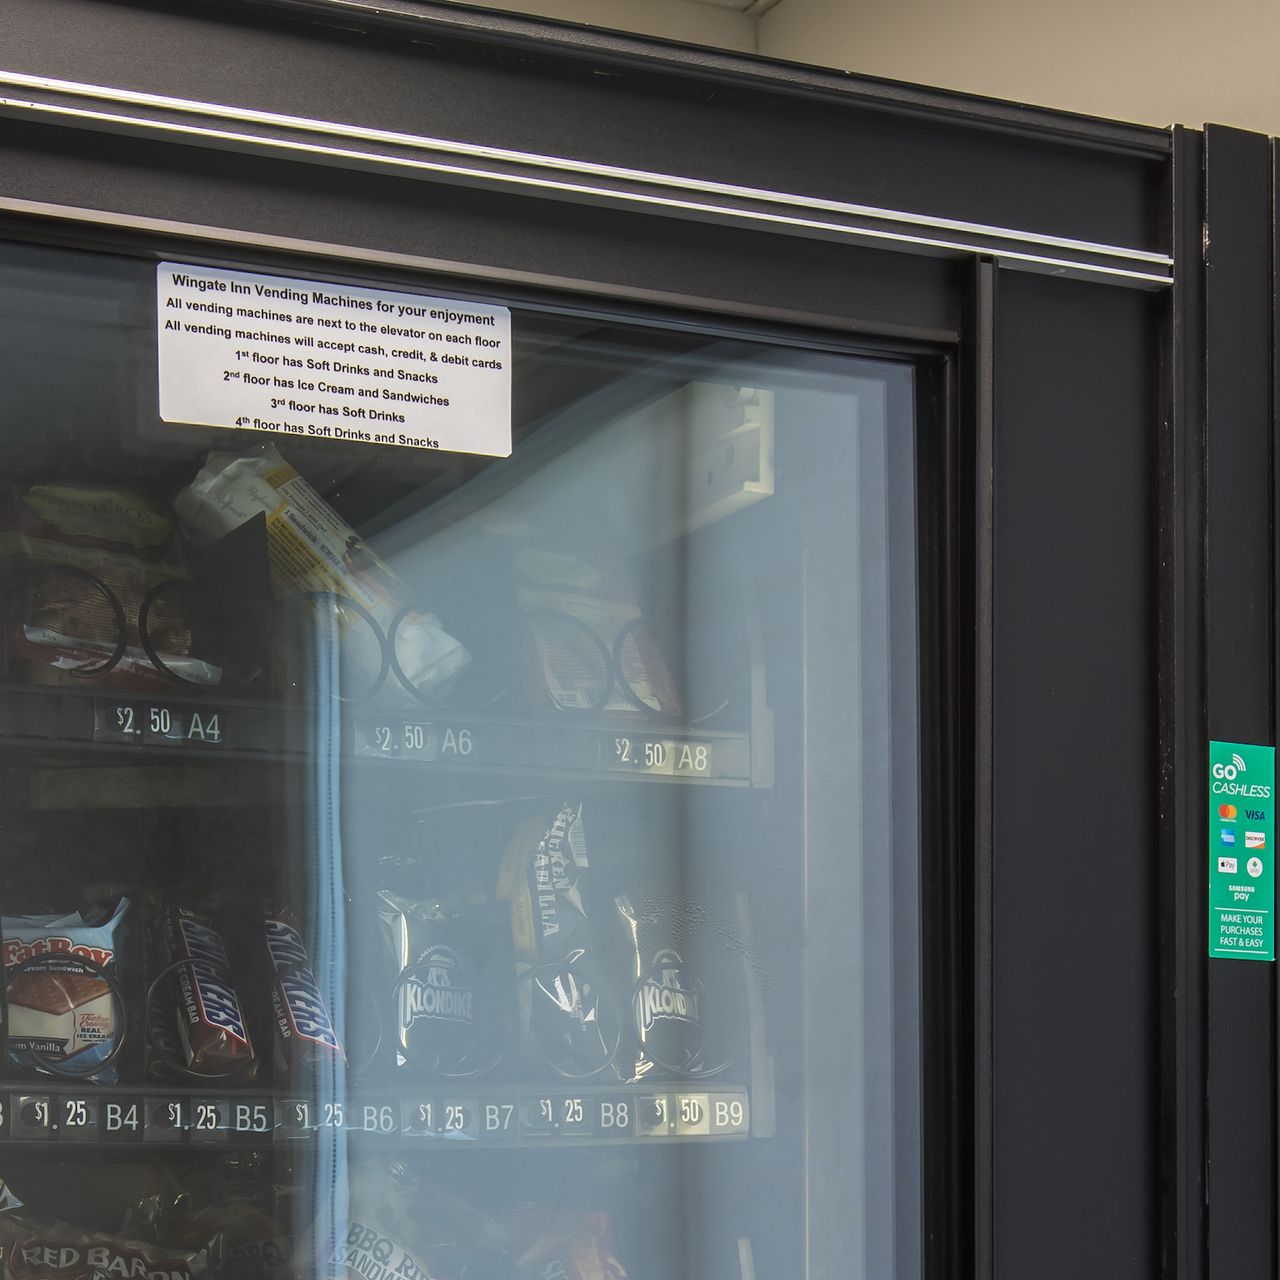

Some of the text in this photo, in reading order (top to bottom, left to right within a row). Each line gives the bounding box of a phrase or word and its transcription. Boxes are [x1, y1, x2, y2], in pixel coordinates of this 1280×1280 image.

[172, 274, 494, 326] Wingate Inn Vending Machines for your enjoyment
[166, 298, 181, 308] All
[186, 302, 232, 317] vending
[237, 309, 292, 322] machines
[296, 316, 313, 325] are
[318, 319, 342, 328] next
[345, 320, 356, 330] to
[360, 322, 377, 332] the
[381, 325, 425, 338] elevator
[446, 335, 471, 344] each
[475, 336, 500, 348] floor
[165, 320, 502, 369] All vending machines will accept cash, credit, & debit cards
[236, 350, 438, 383] 1st floor has Soft Drinks and Snacks
[224, 371, 449, 406] 2nd floor has Ice Cream and Sandwiches
[271, 399, 404, 422] 3rd floor has Soft Drinks
[236, 417, 438, 447] 4th floor has Soft Drinks and Snacks
[1212, 763, 1237, 780] GO
[1212, 782, 1271, 799] CASHLESS
[1245, 810, 1265, 820] VISA
[1225, 860, 1235, 870] Pay
[1234, 892, 1249, 901] pay
[1220, 925, 1263, 936] PURCHASES
[1221, 913, 1263, 925] MAKE YOUR
[1220, 937, 1263, 948] FAST & EASY
[405, 982, 473, 1023] KLONDIKE
[347, 1222, 394, 1267] BBQ
[22, 1246, 80, 1269] RED
